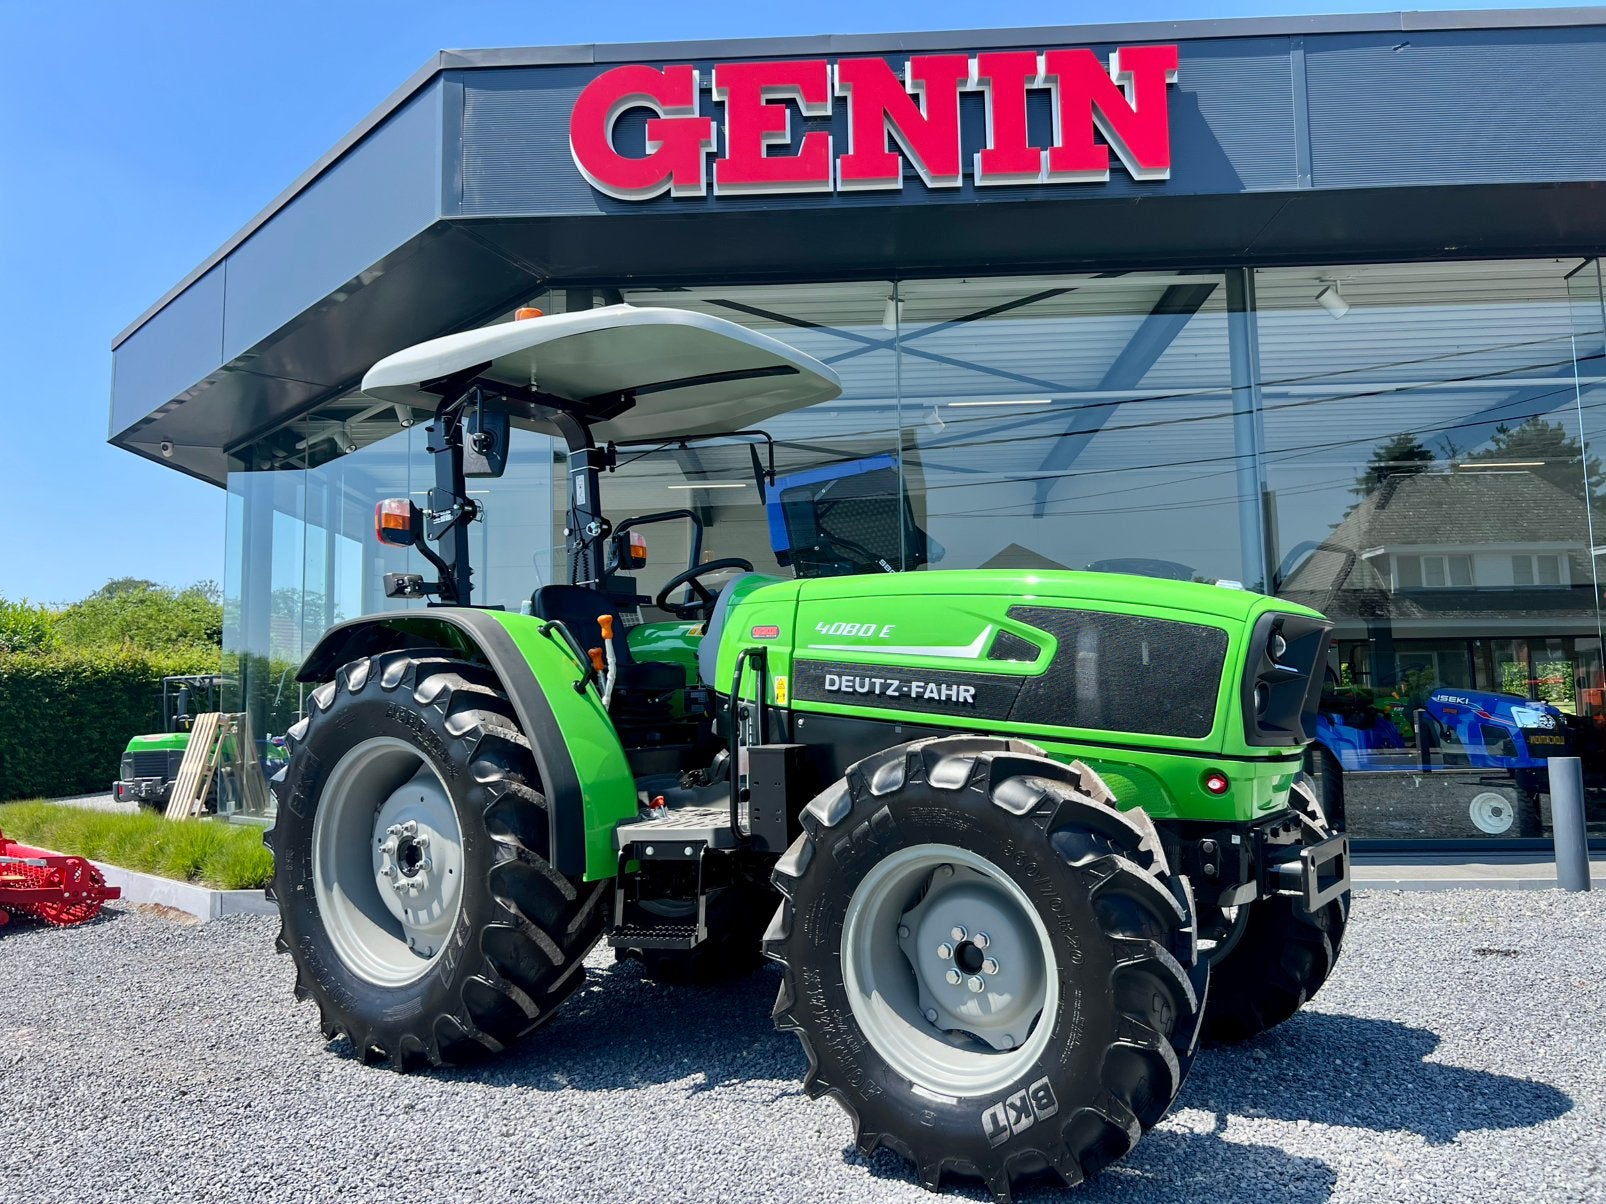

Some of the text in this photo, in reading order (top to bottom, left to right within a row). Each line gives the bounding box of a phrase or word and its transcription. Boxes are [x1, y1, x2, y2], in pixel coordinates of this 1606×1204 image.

[569, 45, 1179, 201] GENIN
[815, 621, 896, 638] 4080 E
[824, 674, 976, 703] DEUTZ-FAHR
[1437, 694, 1469, 705] ISEKI
[981, 1075, 1059, 1150] BKT
